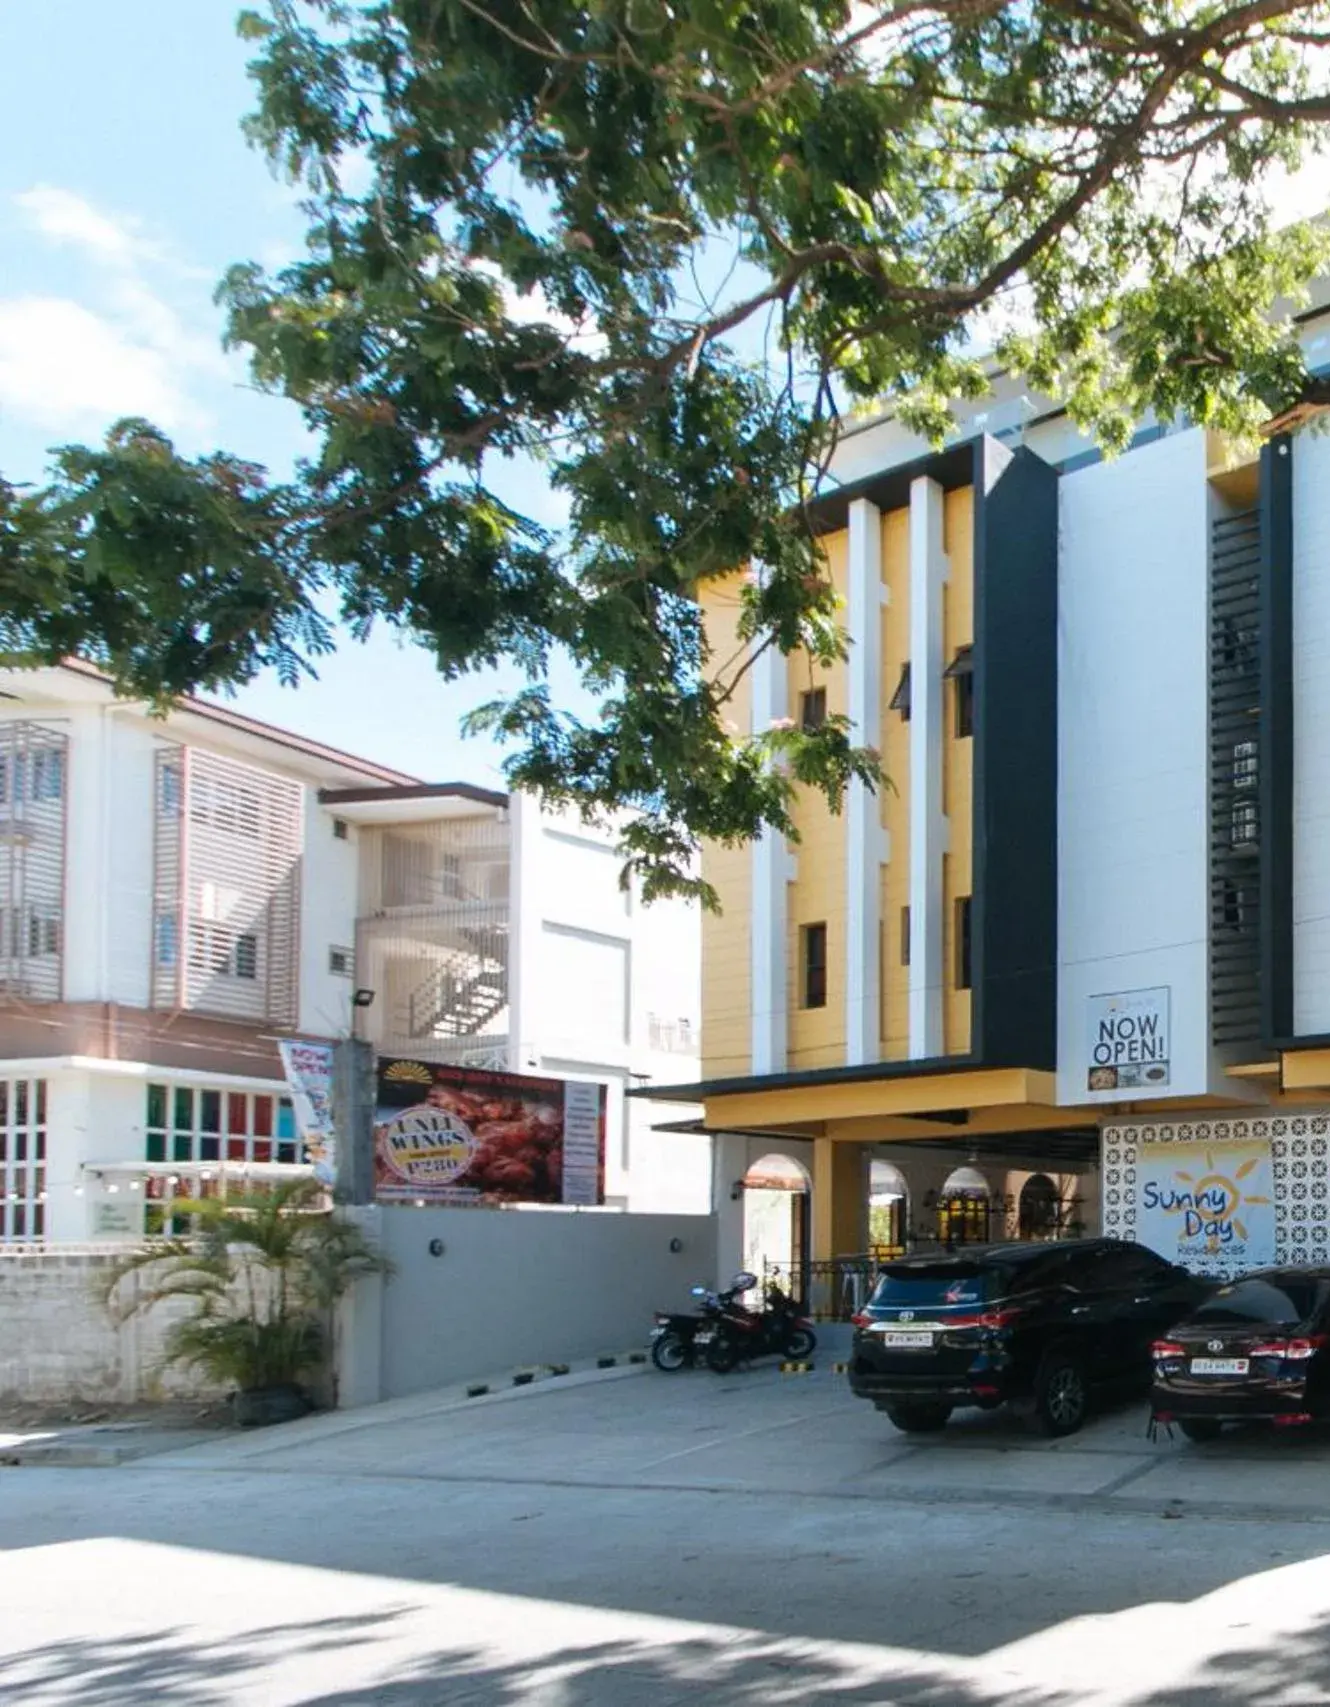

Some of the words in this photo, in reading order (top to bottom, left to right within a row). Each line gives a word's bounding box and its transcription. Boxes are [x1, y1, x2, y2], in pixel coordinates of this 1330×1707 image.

[1099, 1013, 1159, 1042] NOW
[1093, 1036, 1164, 1065] OPEN!
[390, 1132, 466, 1150] WINGS
[1143, 1181, 1226, 1214] Sunny
[1185, 1209, 1234, 1242] Day
